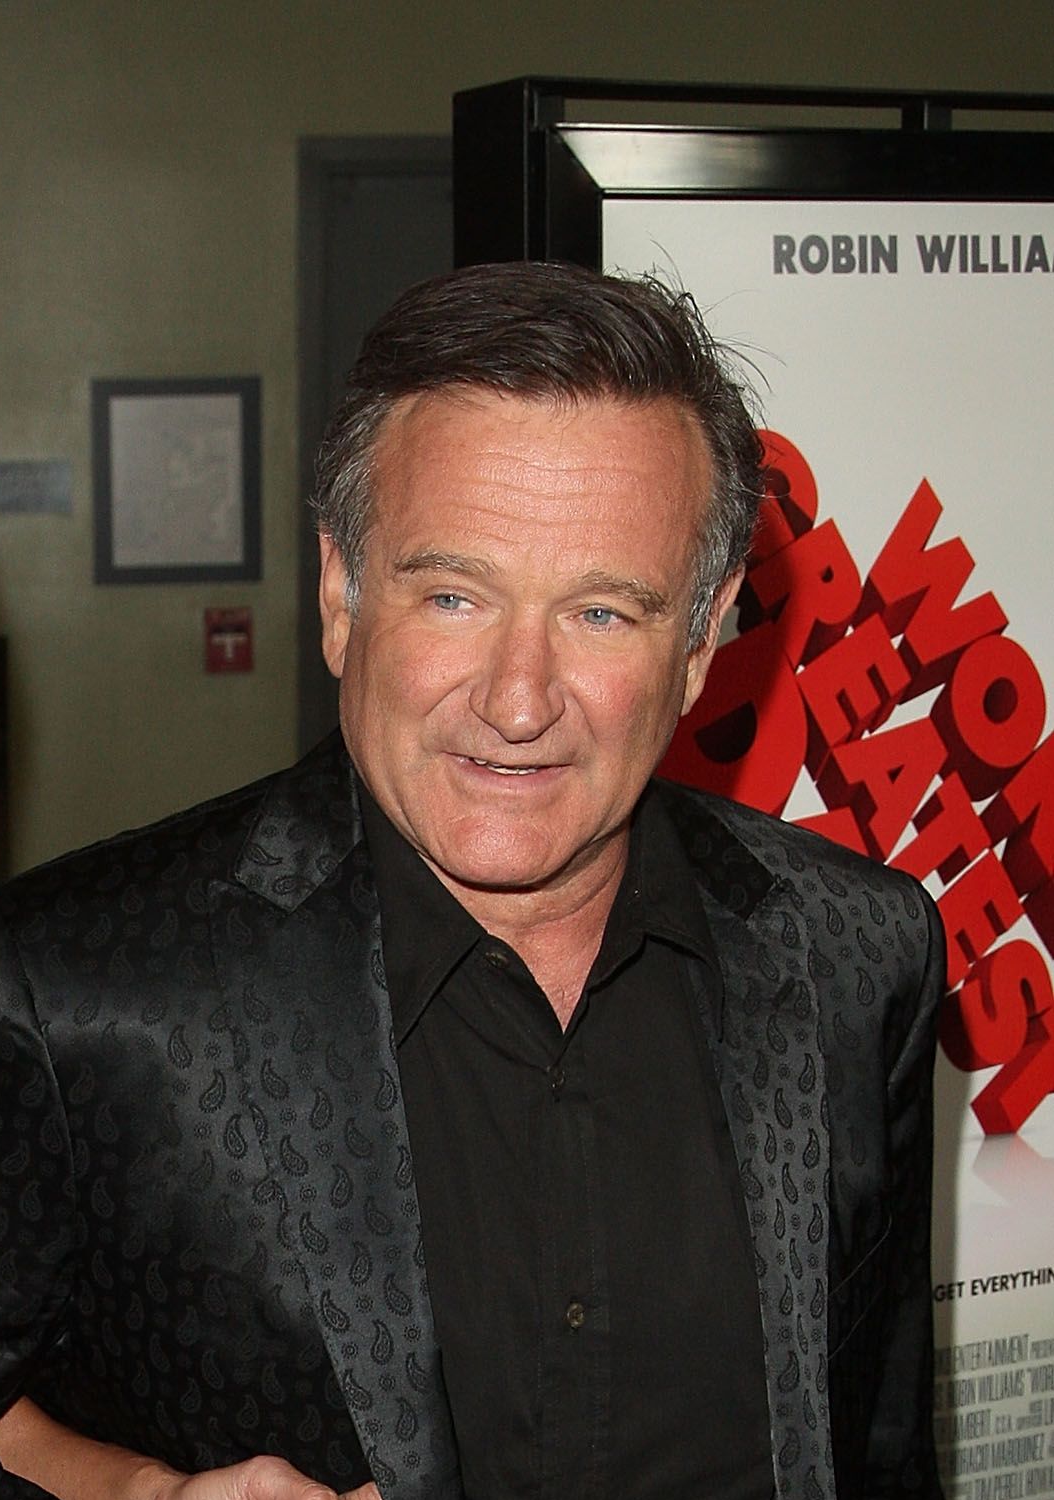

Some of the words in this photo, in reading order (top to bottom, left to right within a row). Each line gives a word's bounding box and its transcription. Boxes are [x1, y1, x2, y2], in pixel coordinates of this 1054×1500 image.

[772, 234, 898, 274] ROBIN
[916, 234, 1054, 274] WILLIA
[934, 1281, 965, 1302] GET
